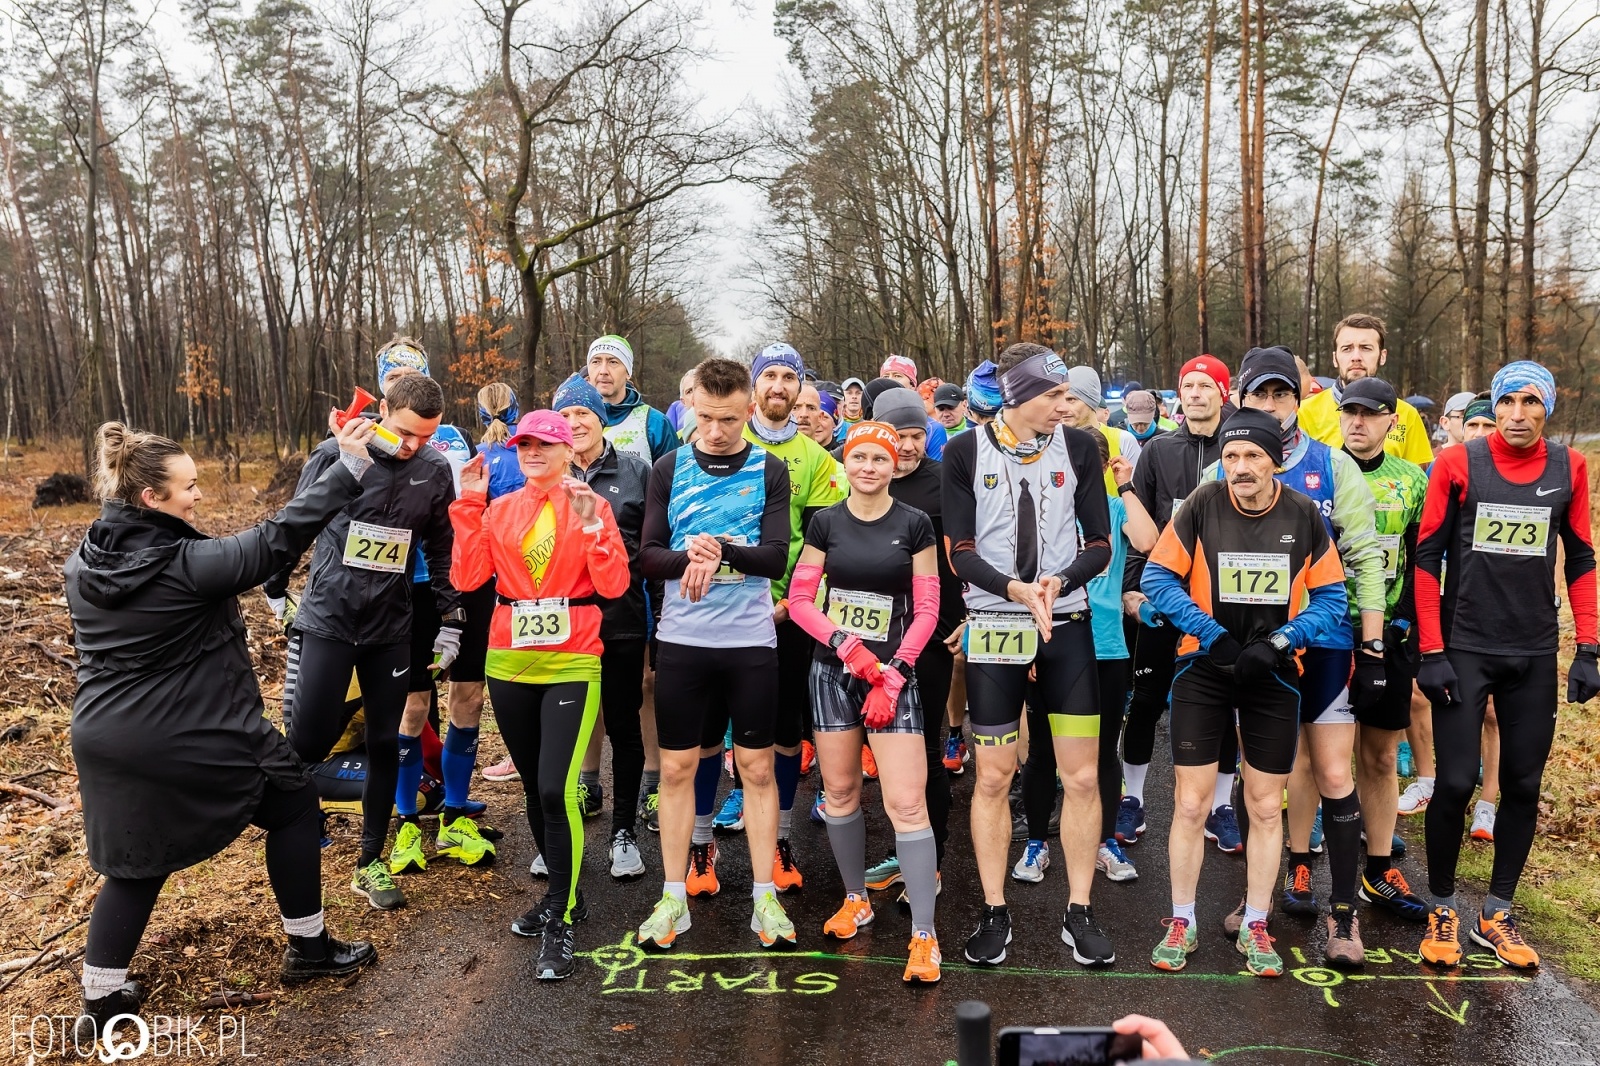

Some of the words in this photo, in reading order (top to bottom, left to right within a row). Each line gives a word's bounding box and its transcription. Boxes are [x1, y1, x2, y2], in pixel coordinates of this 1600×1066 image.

[1224, 429, 1250, 438] SELECT
[1485, 520, 1537, 545] 273
[355, 538, 400, 563] 274
[1232, 569, 1279, 594] 172
[518, 613, 560, 638] 233
[839, 604, 881, 631] 185
[980, 631, 1023, 654] 171
[601, 969, 840, 995] START
